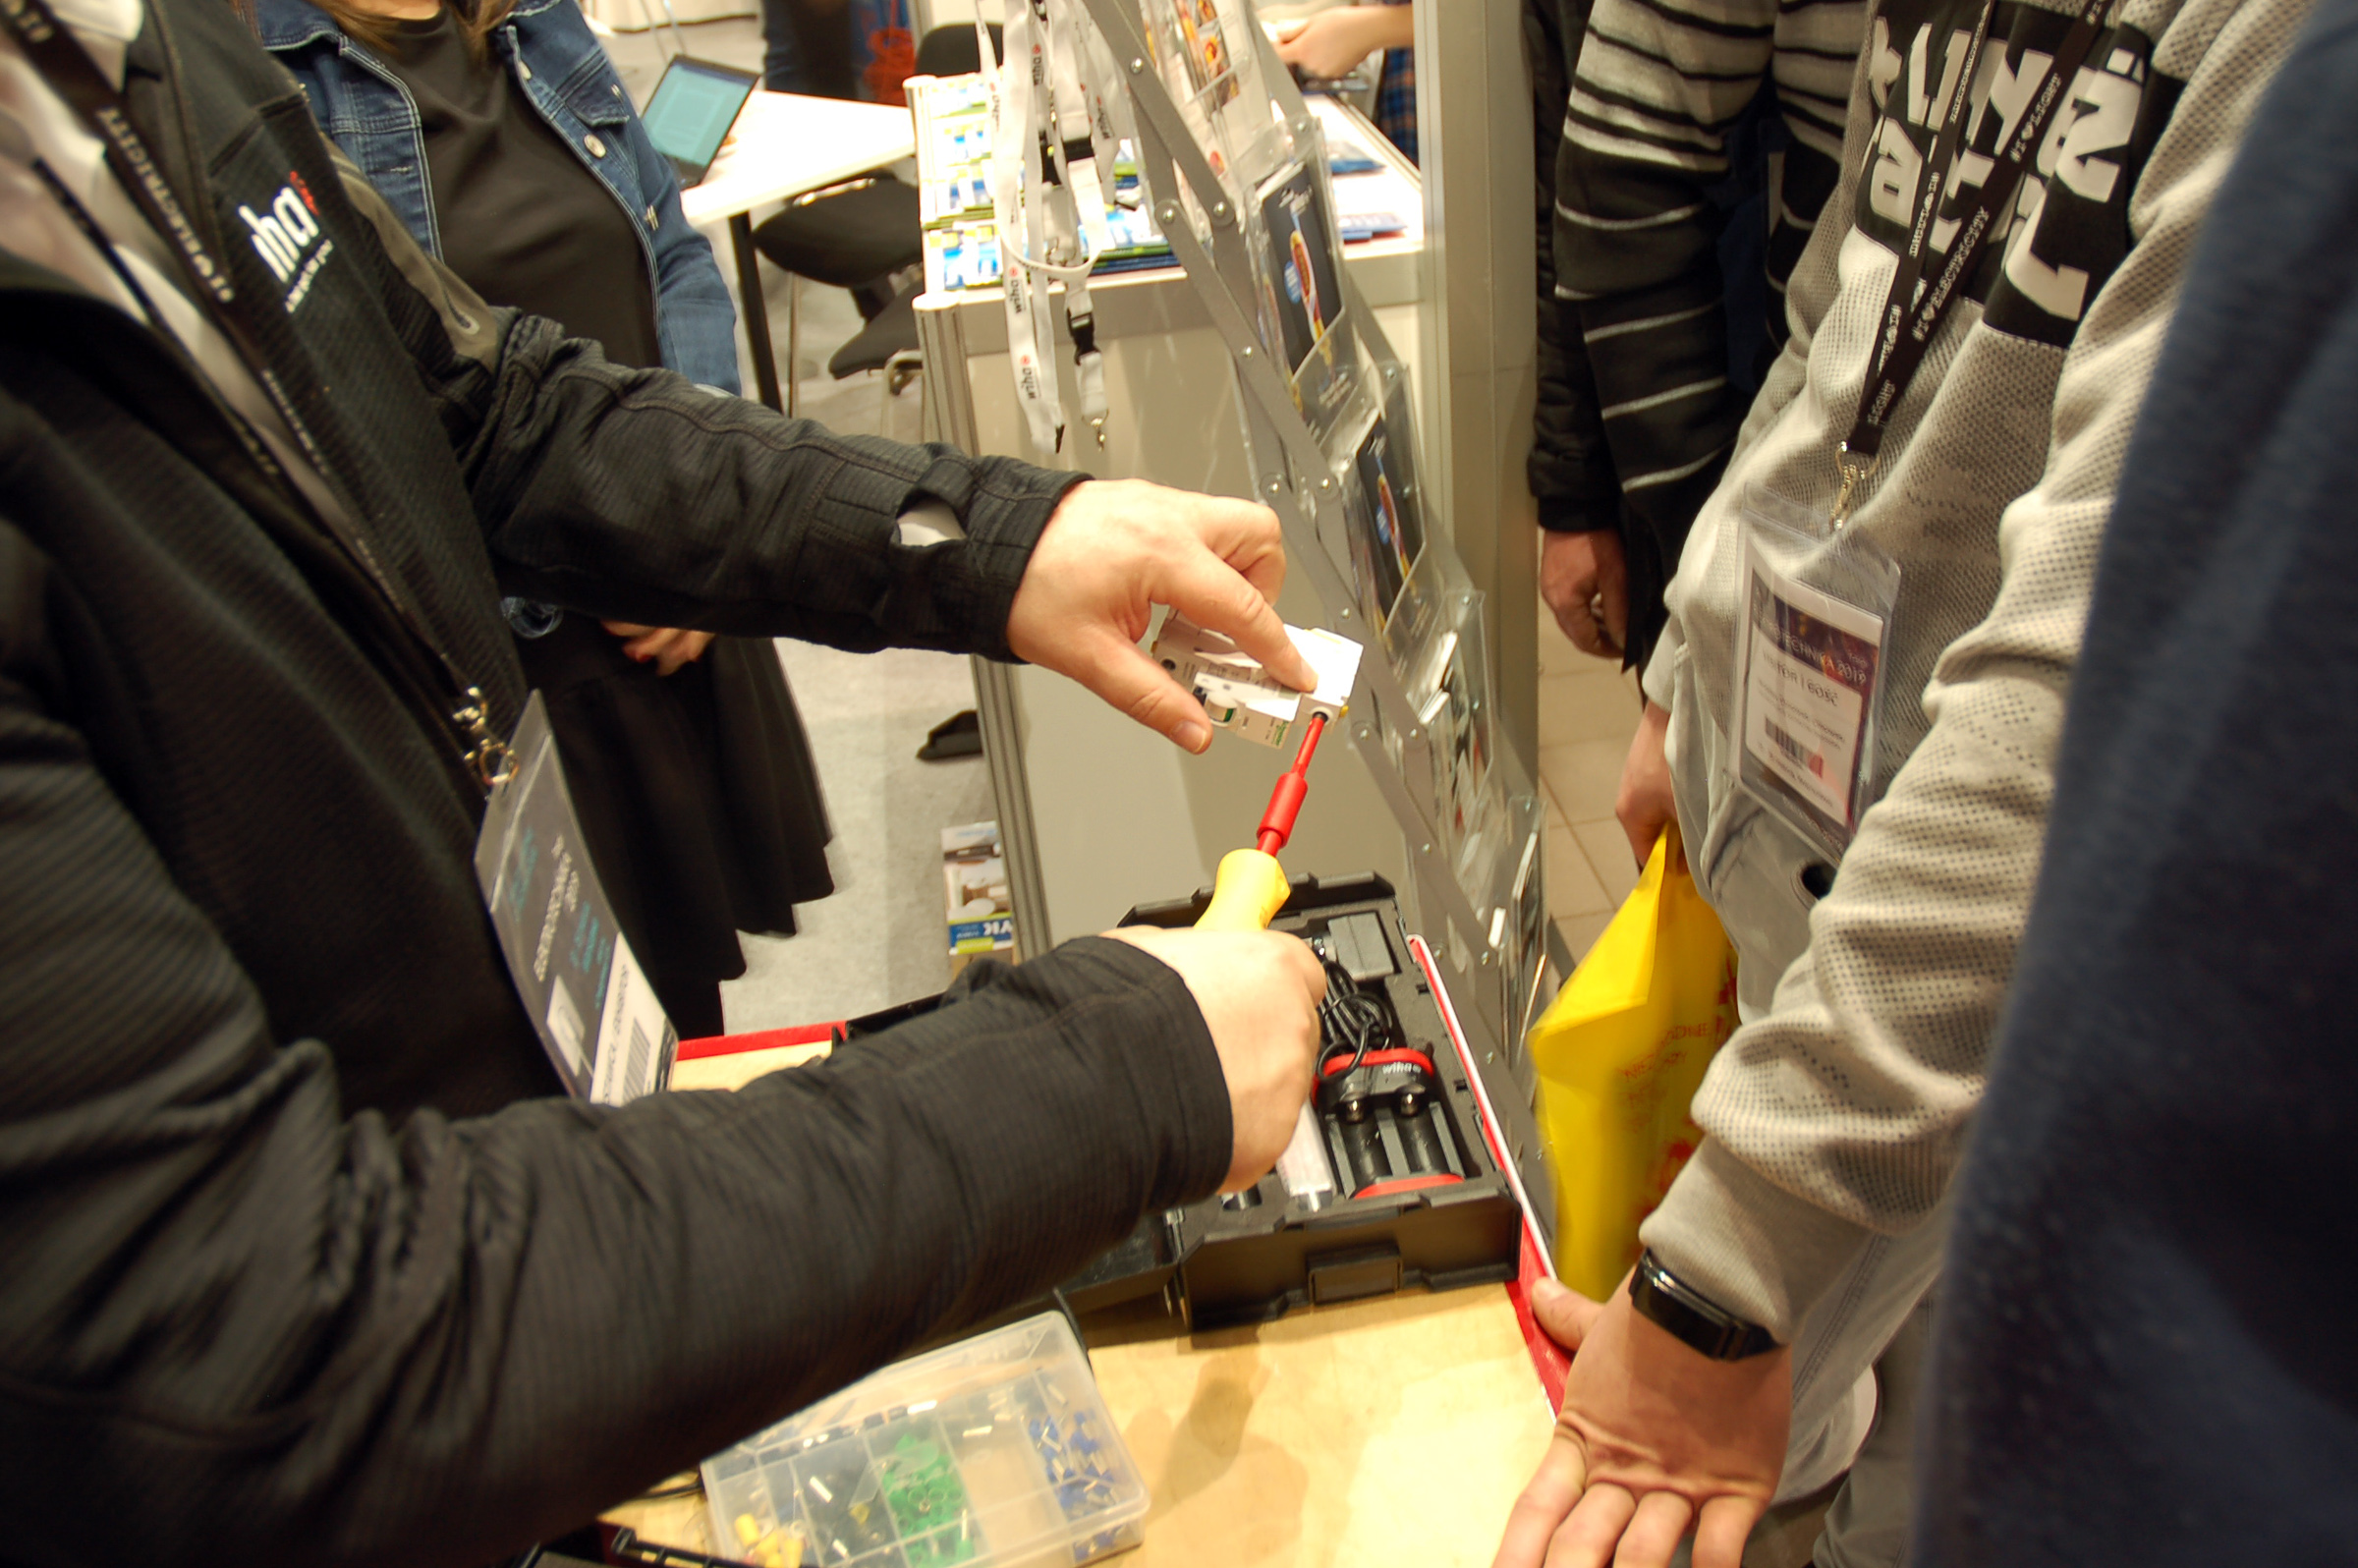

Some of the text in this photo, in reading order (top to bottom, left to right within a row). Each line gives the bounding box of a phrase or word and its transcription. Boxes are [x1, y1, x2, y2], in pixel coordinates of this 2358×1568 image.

[2030, 72, 2062, 125] LIGHT
[1930, 205, 1991, 309] ELECTRICITY
[1010, 280, 1023, 314] wiha
[1020, 366, 1038, 400] wiha
[1381, 1061, 1413, 1075] wiha
